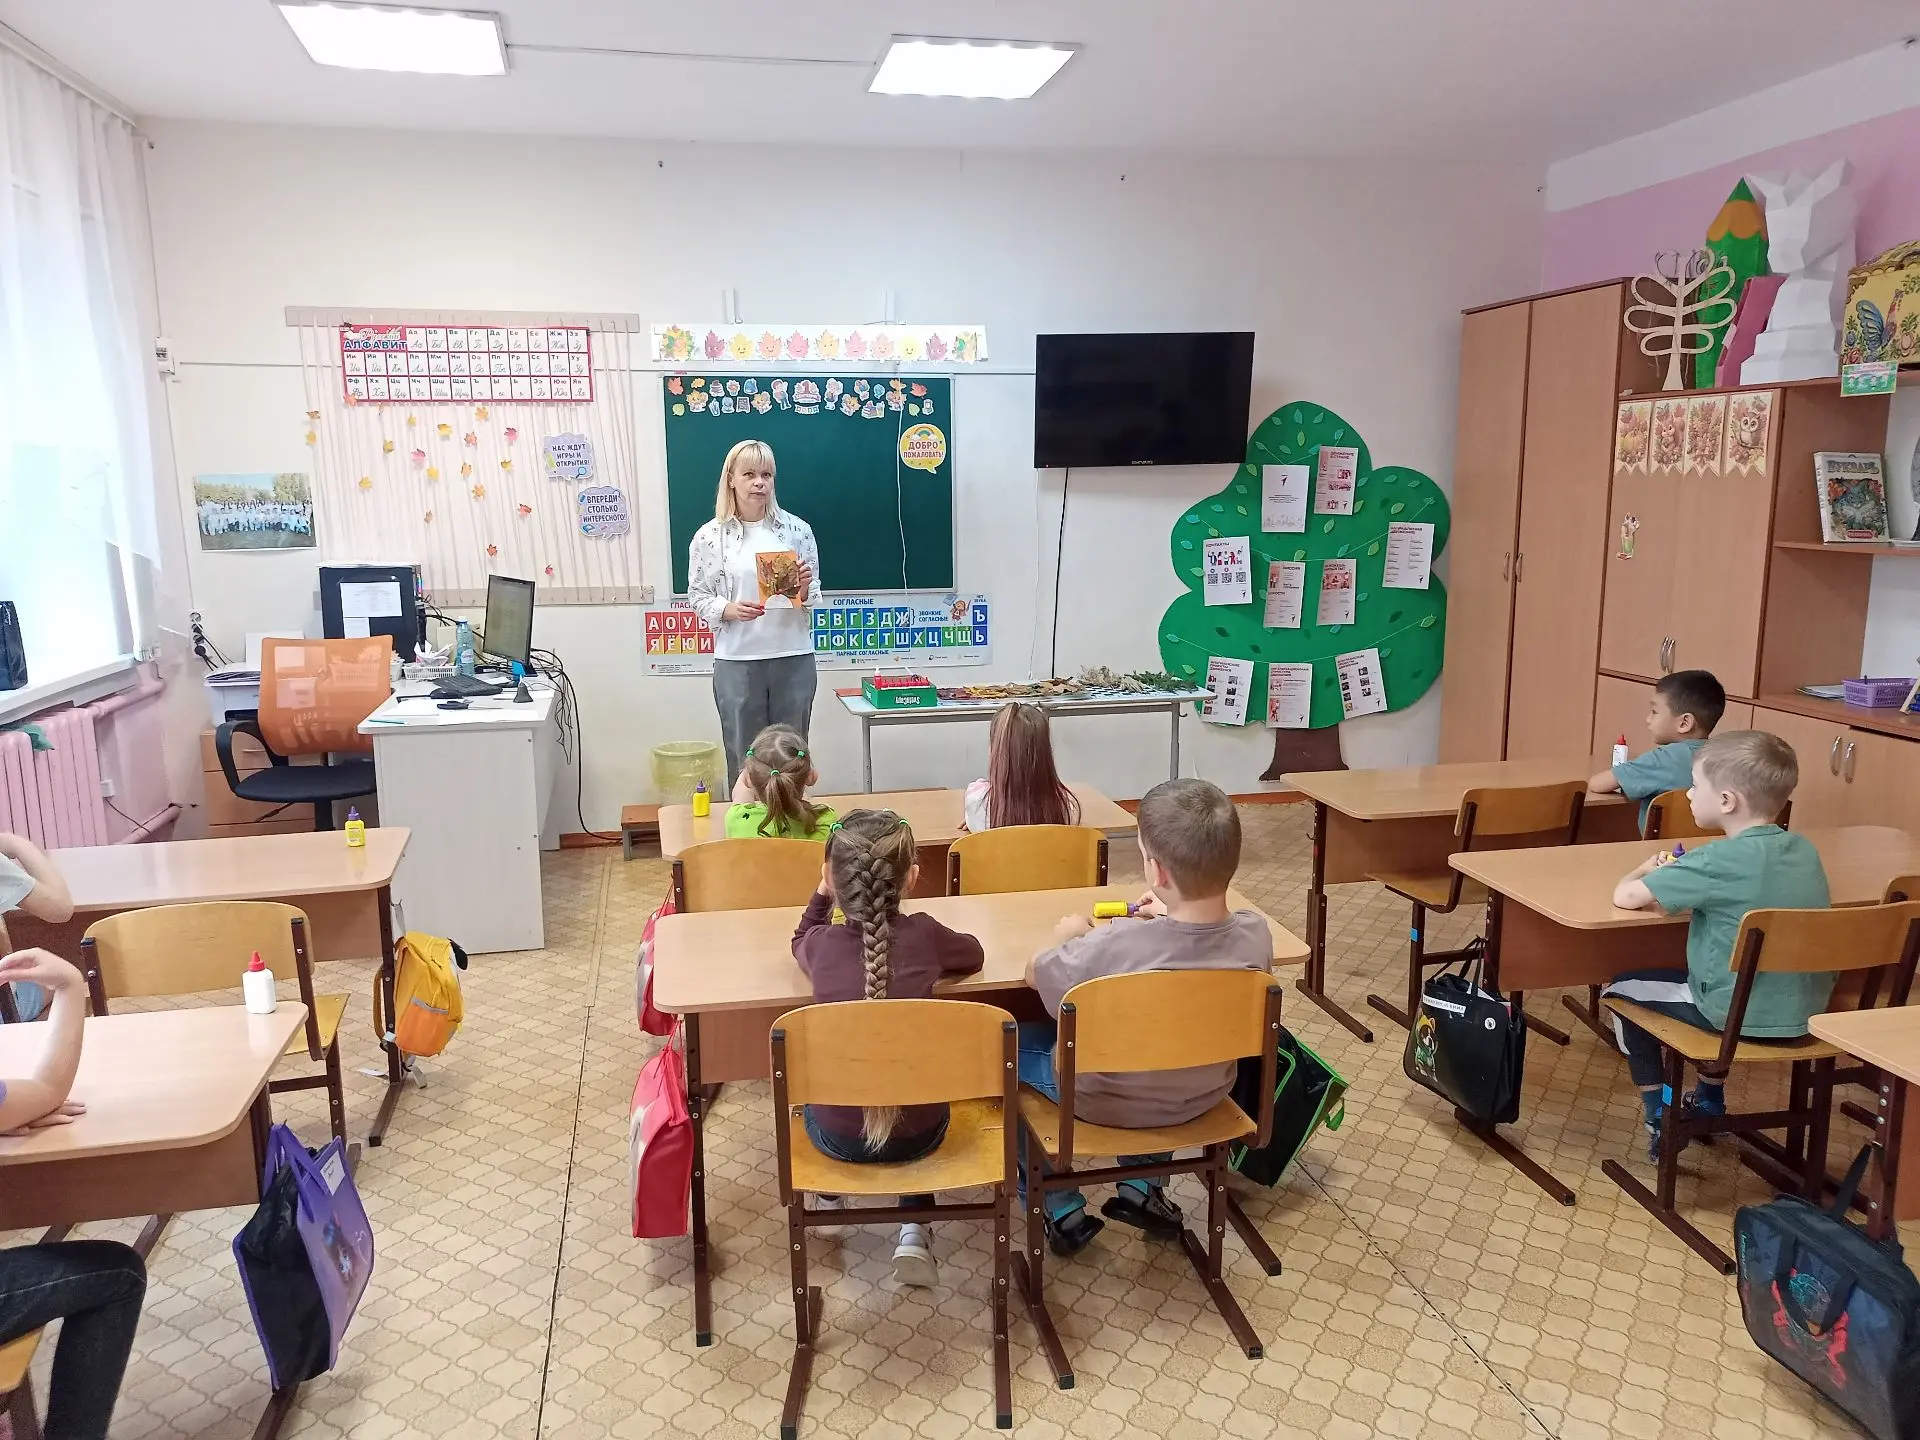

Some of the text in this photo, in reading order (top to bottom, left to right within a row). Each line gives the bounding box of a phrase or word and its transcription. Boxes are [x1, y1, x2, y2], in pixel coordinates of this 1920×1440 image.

[344, 340, 407, 349] АЛФАВИТ
[567, 443, 586, 451] ЖДУТ
[909, 441, 938, 450] ДОБРО
[586, 494, 618, 503] ВПЕРЕДИ
[587, 504, 619, 513] СТОЛЬКО
[583, 513, 626, 523] ИНТЕРЕСНОГО!
[833, 598, 874, 606] СОГЛАСНЫЕ
[816, 613, 826, 626] Б
[833, 613, 843, 626] В
[850, 612, 858, 625] Г
[866, 612, 875, 625] З
[880, 611, 893, 627] Д
[973, 610, 986, 622] Ъ
[648, 616, 660, 631] А
[665, 616, 677, 630] О
[682, 616, 693, 630] У
[817, 634, 827, 647] П
[832, 634, 844, 647] Ф
[849, 633, 859, 646] К
[866, 633, 874, 646] С
[882, 632, 891, 645] Т
[896, 632, 909, 645] Ш
[913, 632, 923, 645] Х
[928, 631, 939, 646] Ц
[975, 629, 985, 643] Ь
[650, 635, 711, 651] Я Ё Ю И
